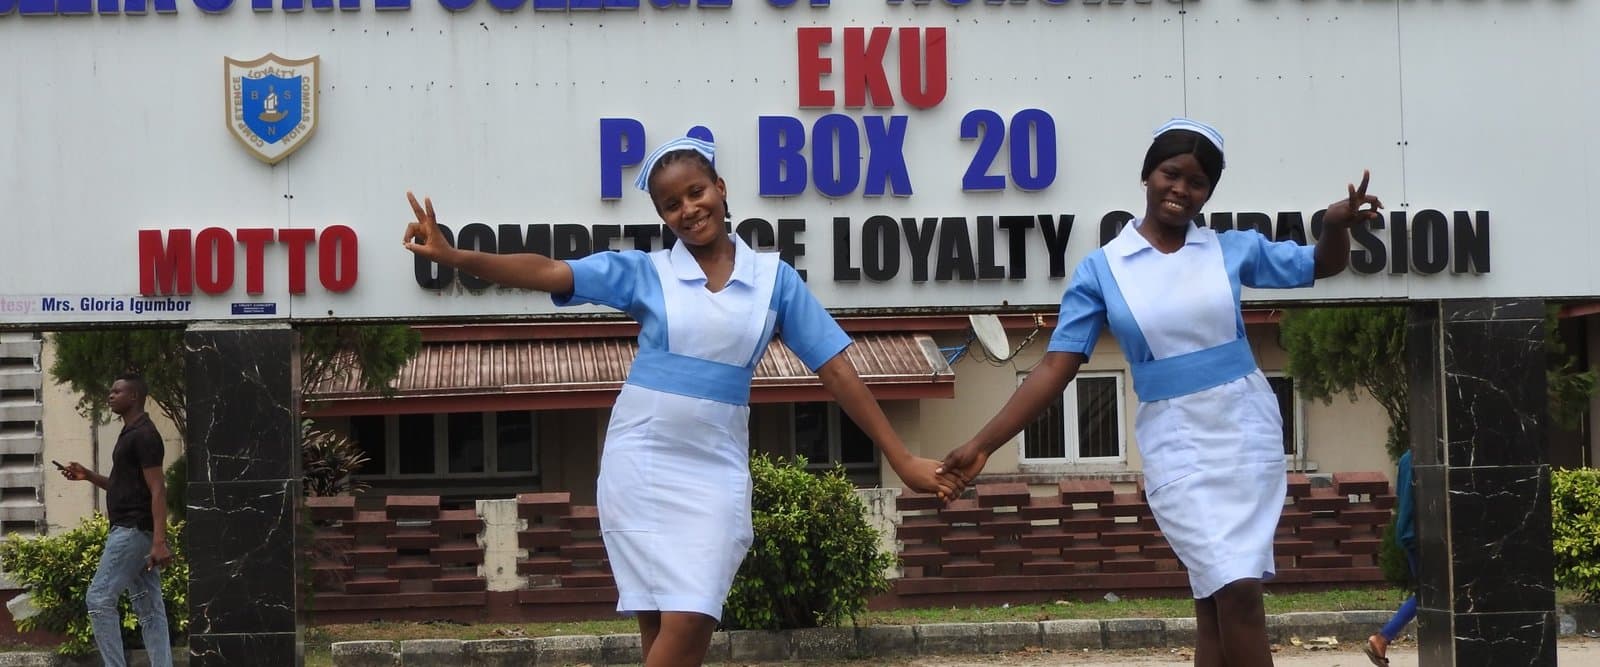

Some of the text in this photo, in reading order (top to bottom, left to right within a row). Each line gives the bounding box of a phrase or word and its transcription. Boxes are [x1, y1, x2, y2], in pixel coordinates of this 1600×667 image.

[248, 66, 297, 79] LOYALTY
[797, 27, 948, 109] EKU
[758, 113, 913, 199] BOX
[960, 108, 1058, 193] 20
[138, 208, 1491, 298] MOTTO COMPETCE LOYALTY ASION
[41, 297, 75, 312] Mrs.
[80, 297, 124, 312] Gloria
[129, 297, 192, 315] Igumbor
